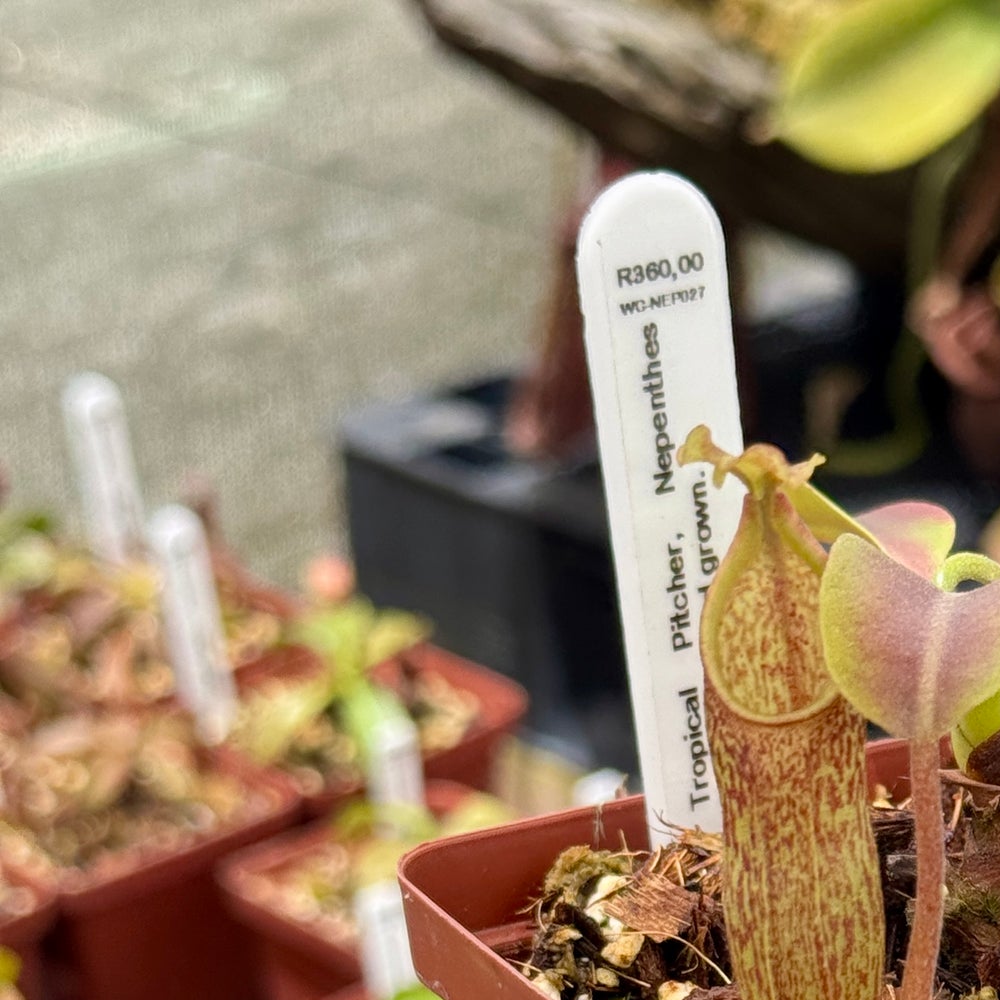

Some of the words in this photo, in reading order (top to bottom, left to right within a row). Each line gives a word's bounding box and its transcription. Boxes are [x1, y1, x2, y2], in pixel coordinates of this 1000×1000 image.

[617, 252, 704, 288] R360,00
[642, 322, 676, 495] Nepenthes
[692, 470, 720, 576] grown.
[667, 532, 693, 652] Pitcher,
[679, 686, 710, 812] Tropical
